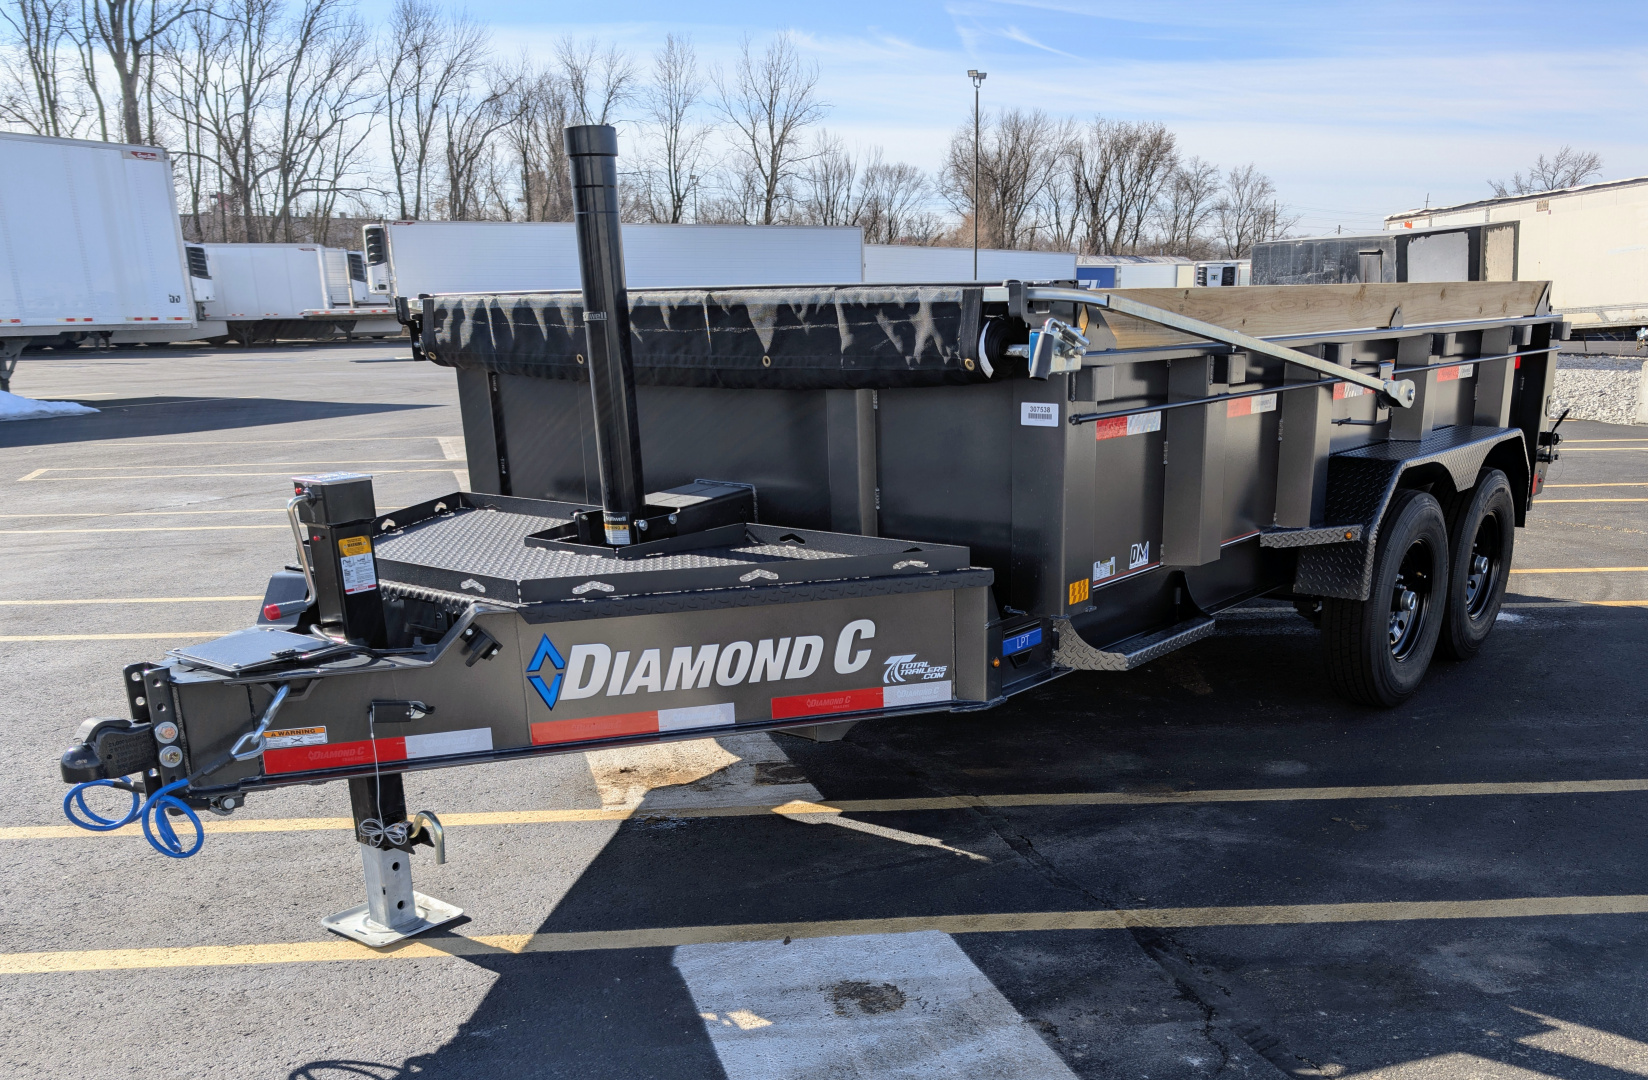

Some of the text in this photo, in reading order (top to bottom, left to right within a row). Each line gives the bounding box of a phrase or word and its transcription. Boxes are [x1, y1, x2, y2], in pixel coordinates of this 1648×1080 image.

[1131, 541, 1149, 564] DM
[1016, 634, 1030, 649] LPT
[559, 618, 876, 701] DIAMOND C
[901, 661, 930, 670] TOTAL
[900, 665, 948, 676] TRAILERS
[921, 672, 945, 680] .COM
[811, 695, 852, 707] DIAMOND C
[277, 728, 316, 736] WARNING
[313, 746, 365, 760] DIAMOND C
